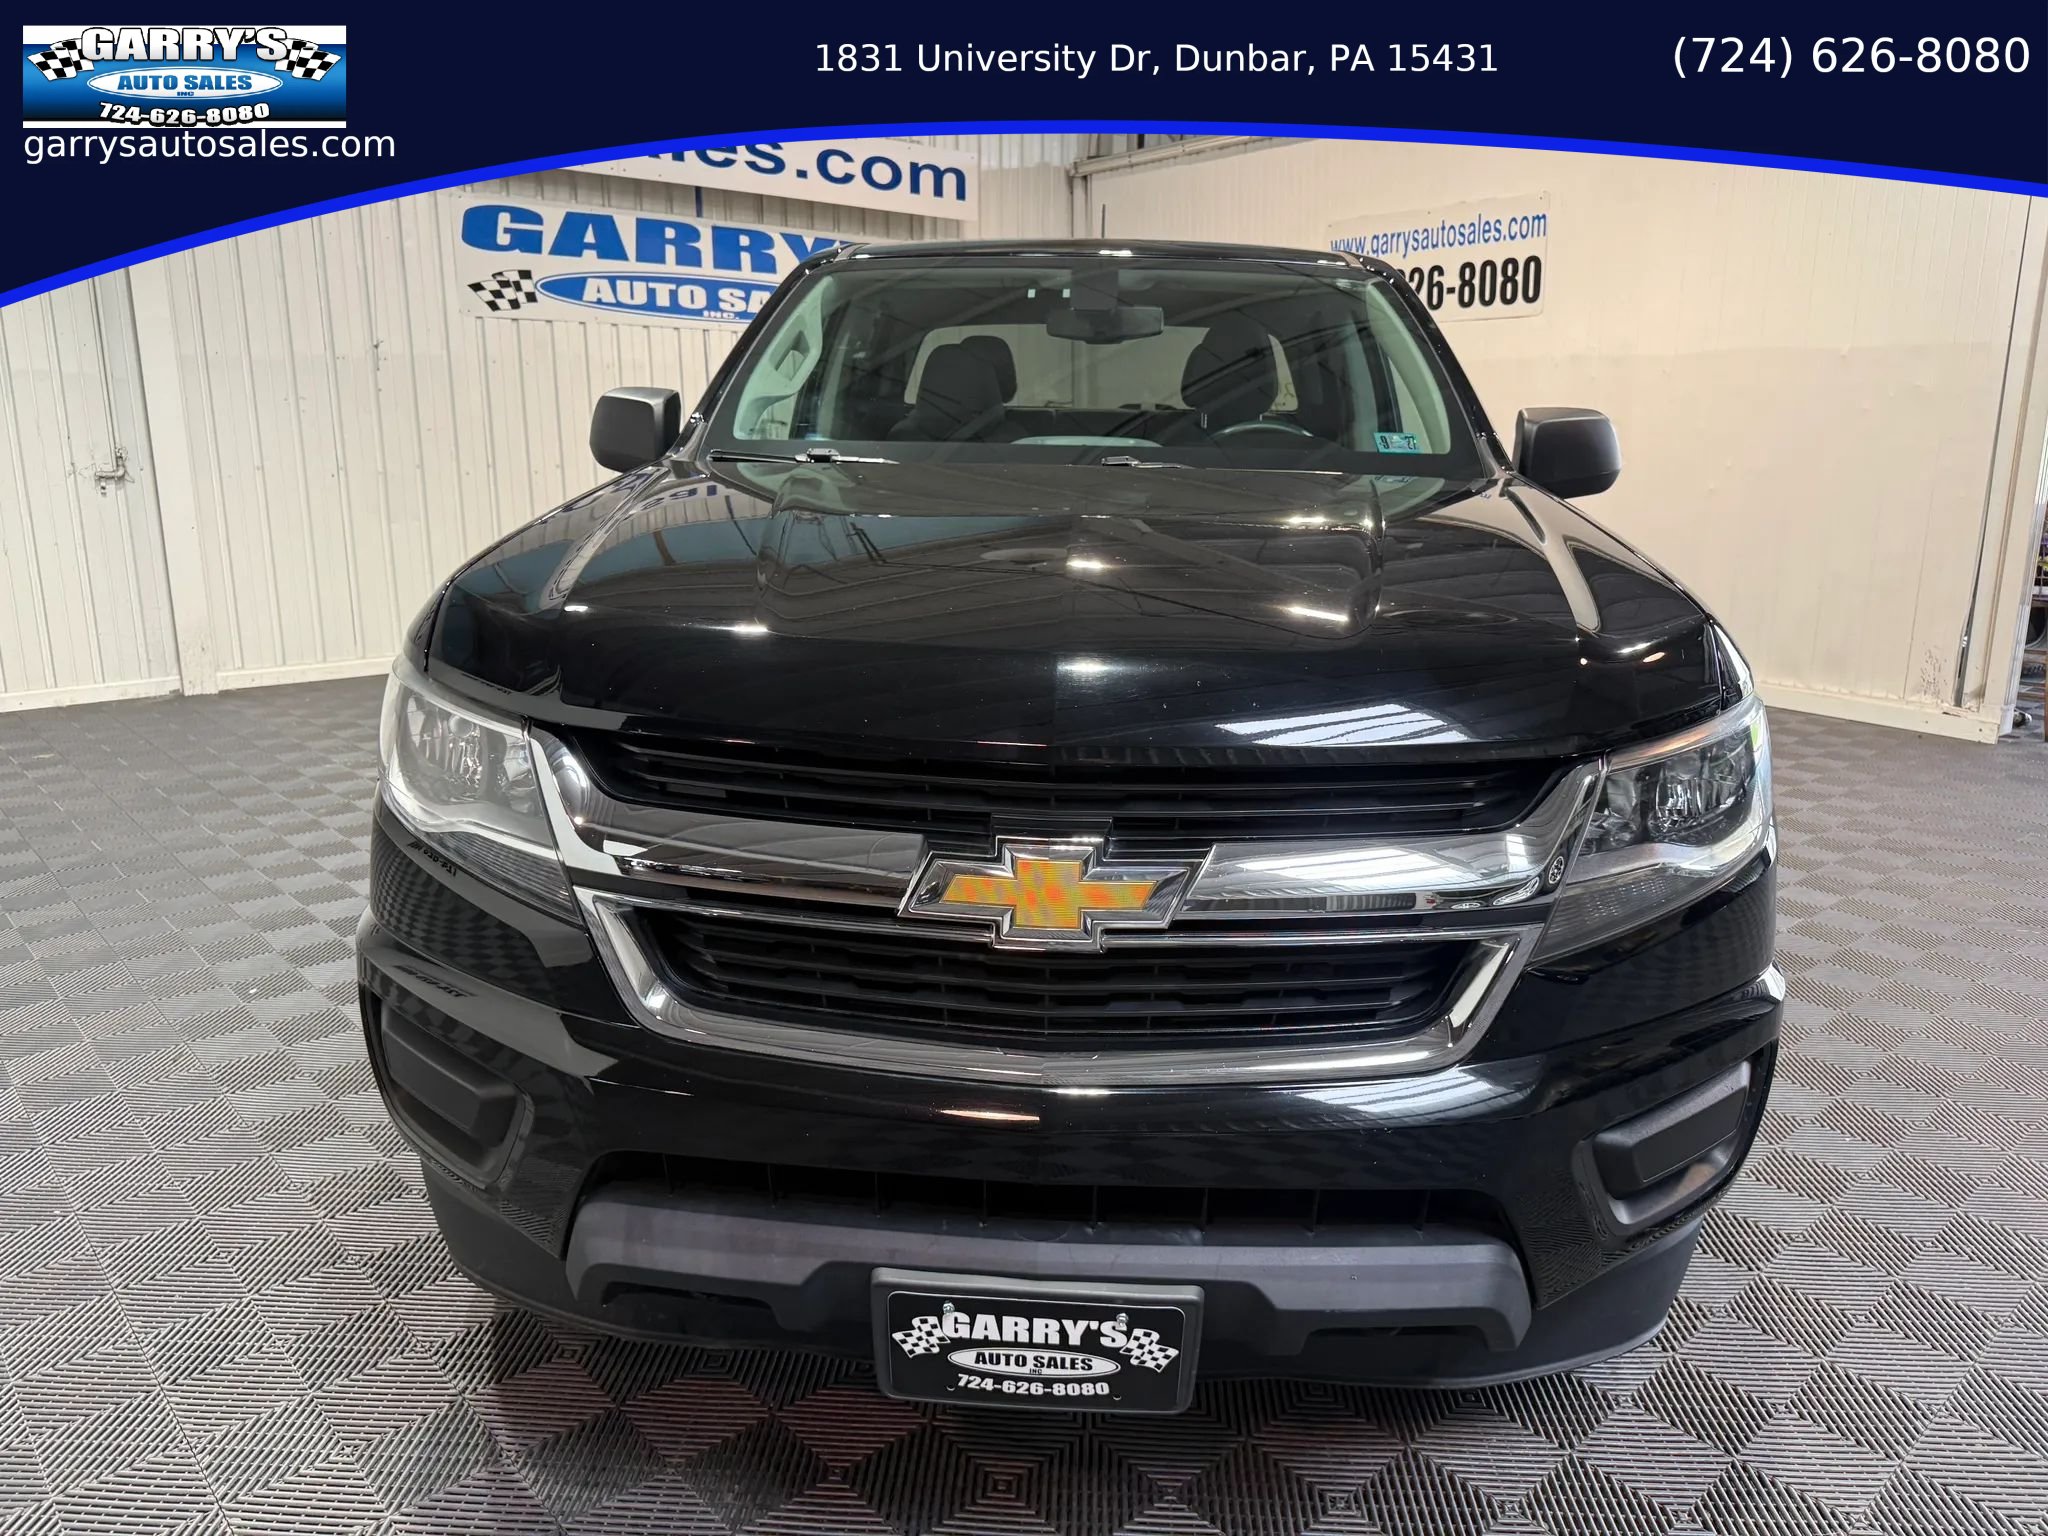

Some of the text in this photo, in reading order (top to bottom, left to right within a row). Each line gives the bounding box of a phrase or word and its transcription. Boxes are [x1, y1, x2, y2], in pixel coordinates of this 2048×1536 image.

[1330, 213, 1547, 259] www.garrysautosales.com
[582, 278, 706, 310] AUTO
[1396, 255, 1542, 310] 26-8080
[702, 310, 740, 320] INC.
[942, 1311, 1128, 1348] GARRY'S
[974, 1351, 1093, 1371] AUTO SALES
[957, 1373, 1110, 1396] 724-626-8080
